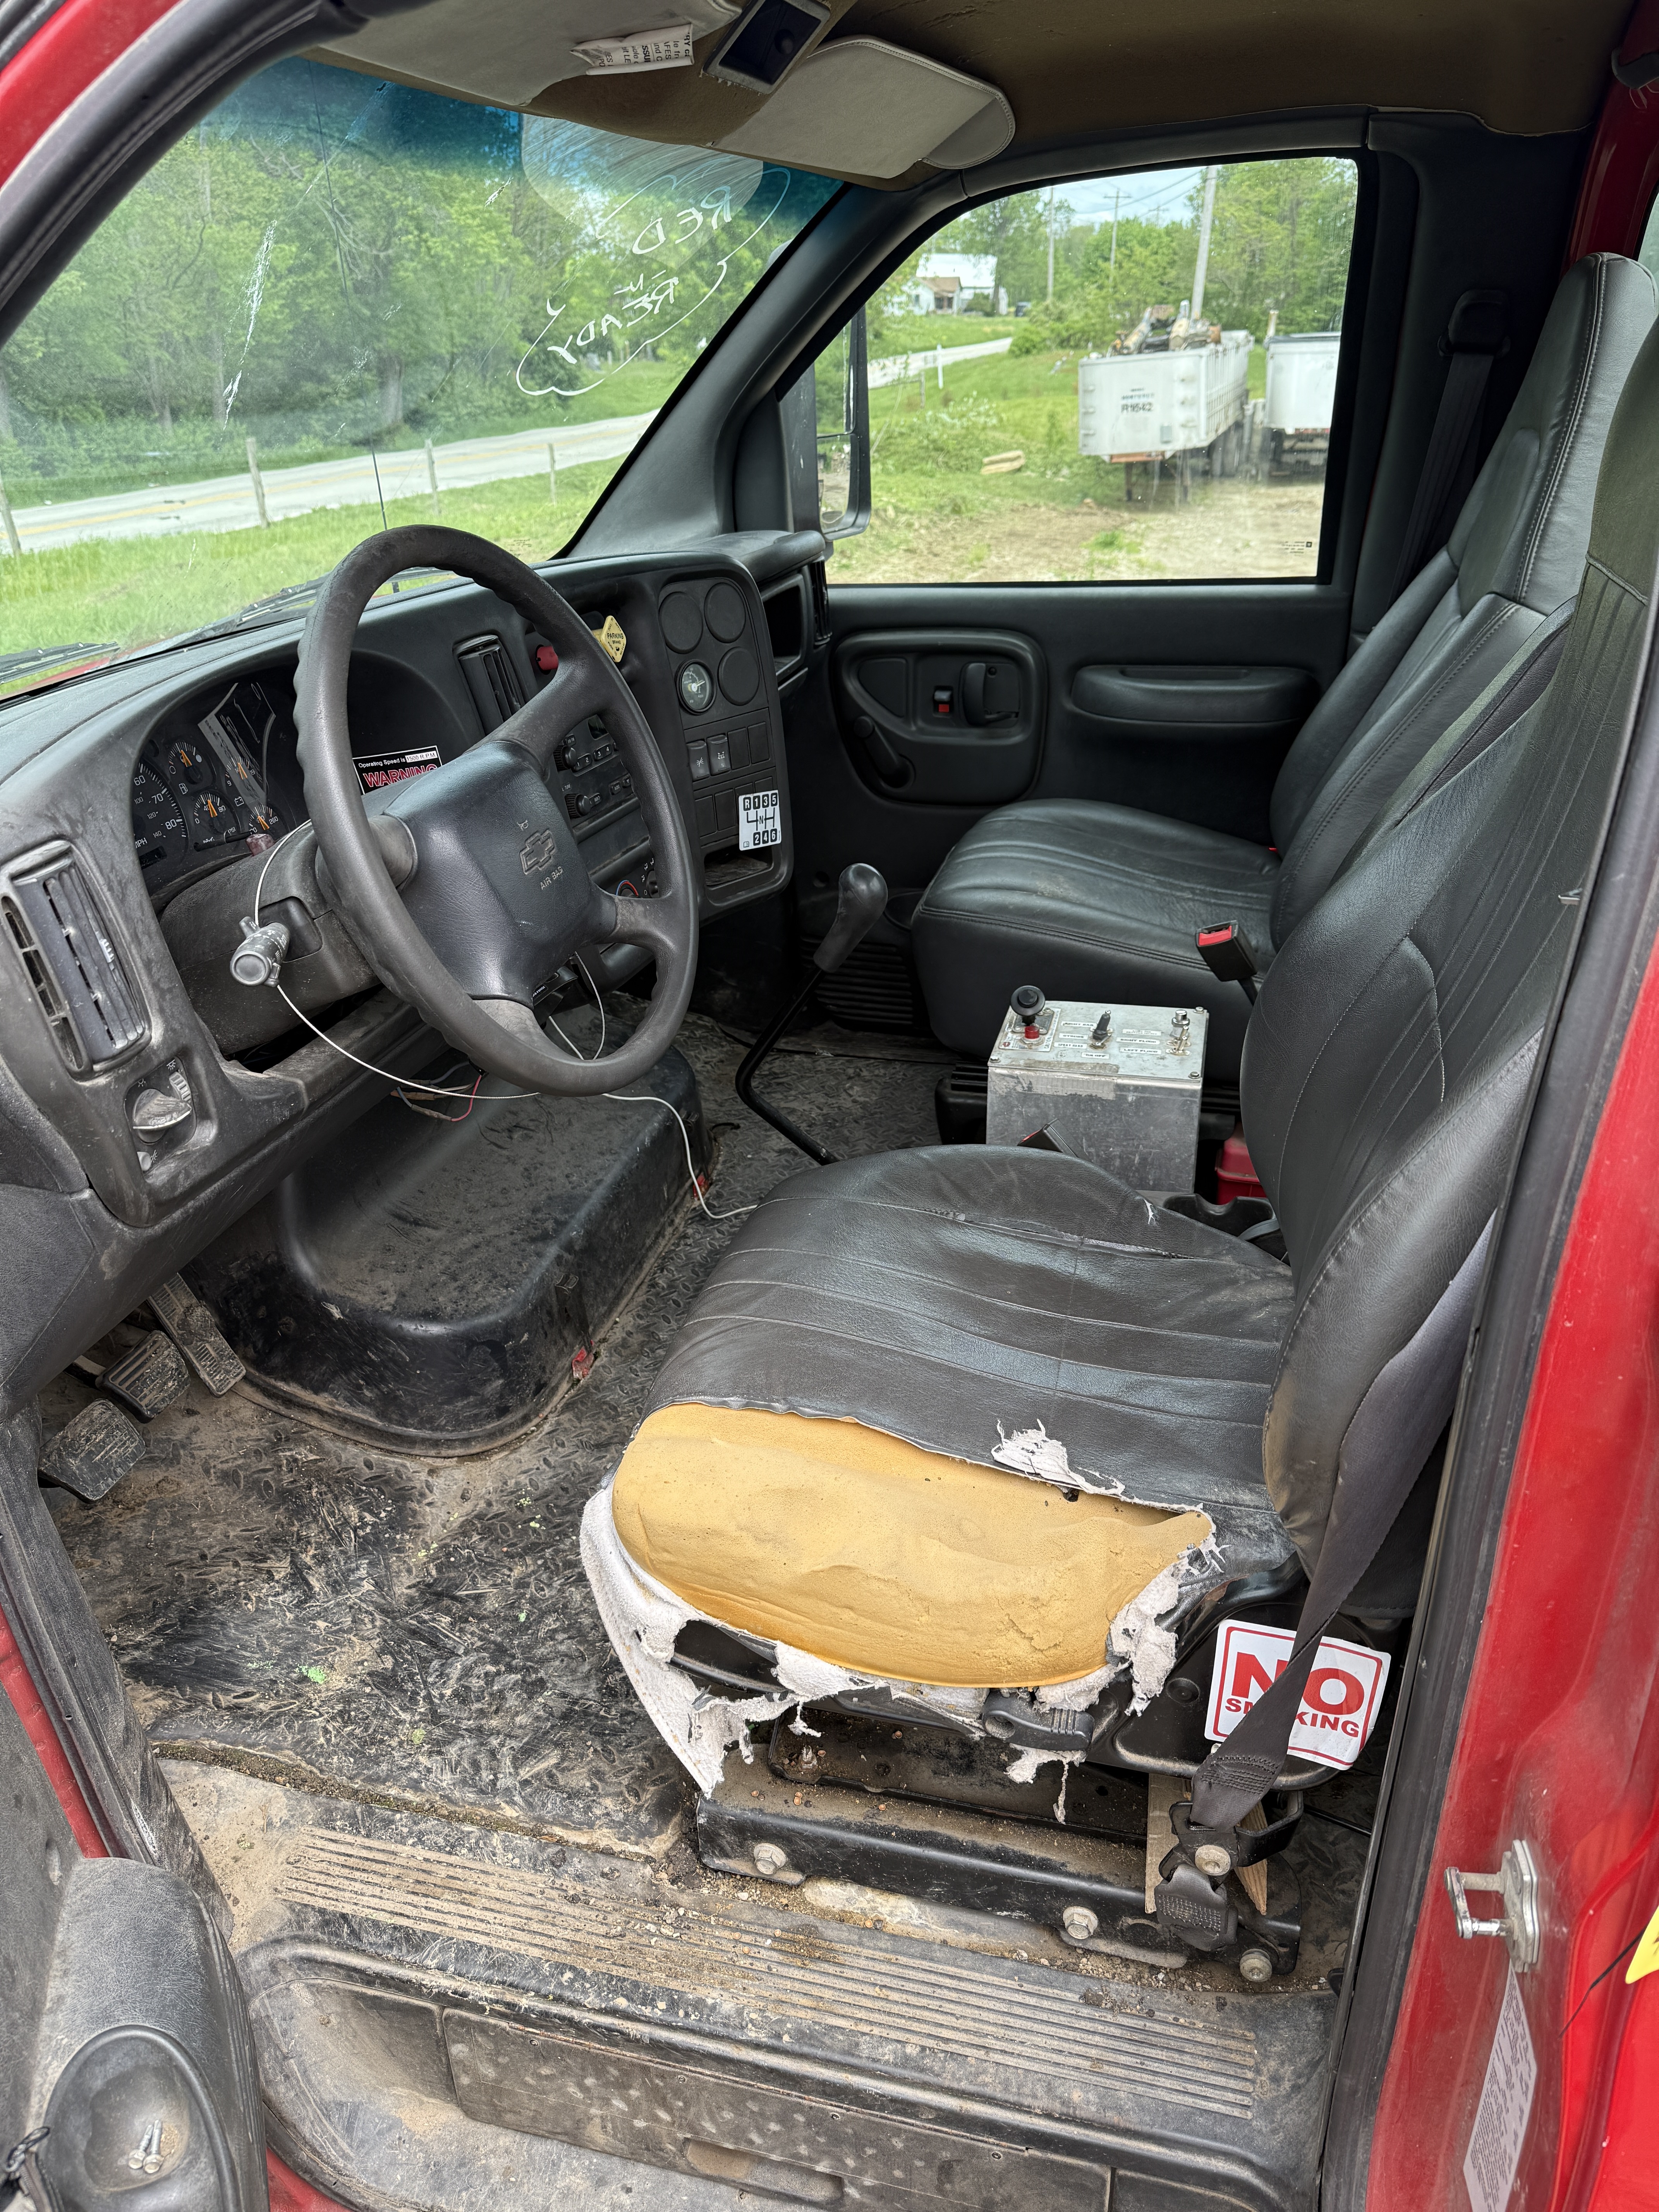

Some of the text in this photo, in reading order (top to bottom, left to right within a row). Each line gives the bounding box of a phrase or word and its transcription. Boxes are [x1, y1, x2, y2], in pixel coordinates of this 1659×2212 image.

[134, 775, 146, 786] 60
[134, 797, 144, 805] 100
[151, 793, 164, 804] 70
[745, 795, 776, 809] R 1 3 5
[165, 819, 177, 830] 80
[268, 816, 278, 824] 260
[759, 815, 764, 824] N
[153, 830, 162, 839] 140
[755, 834, 759, 844] 2
[763, 832, 768, 842] 4
[771, 831, 776, 840] 6
[540, 866, 563, 890] AIR BAG
[1231, 1652, 1365, 1715] NO
[1225, 1697, 1360, 1738] SKING
